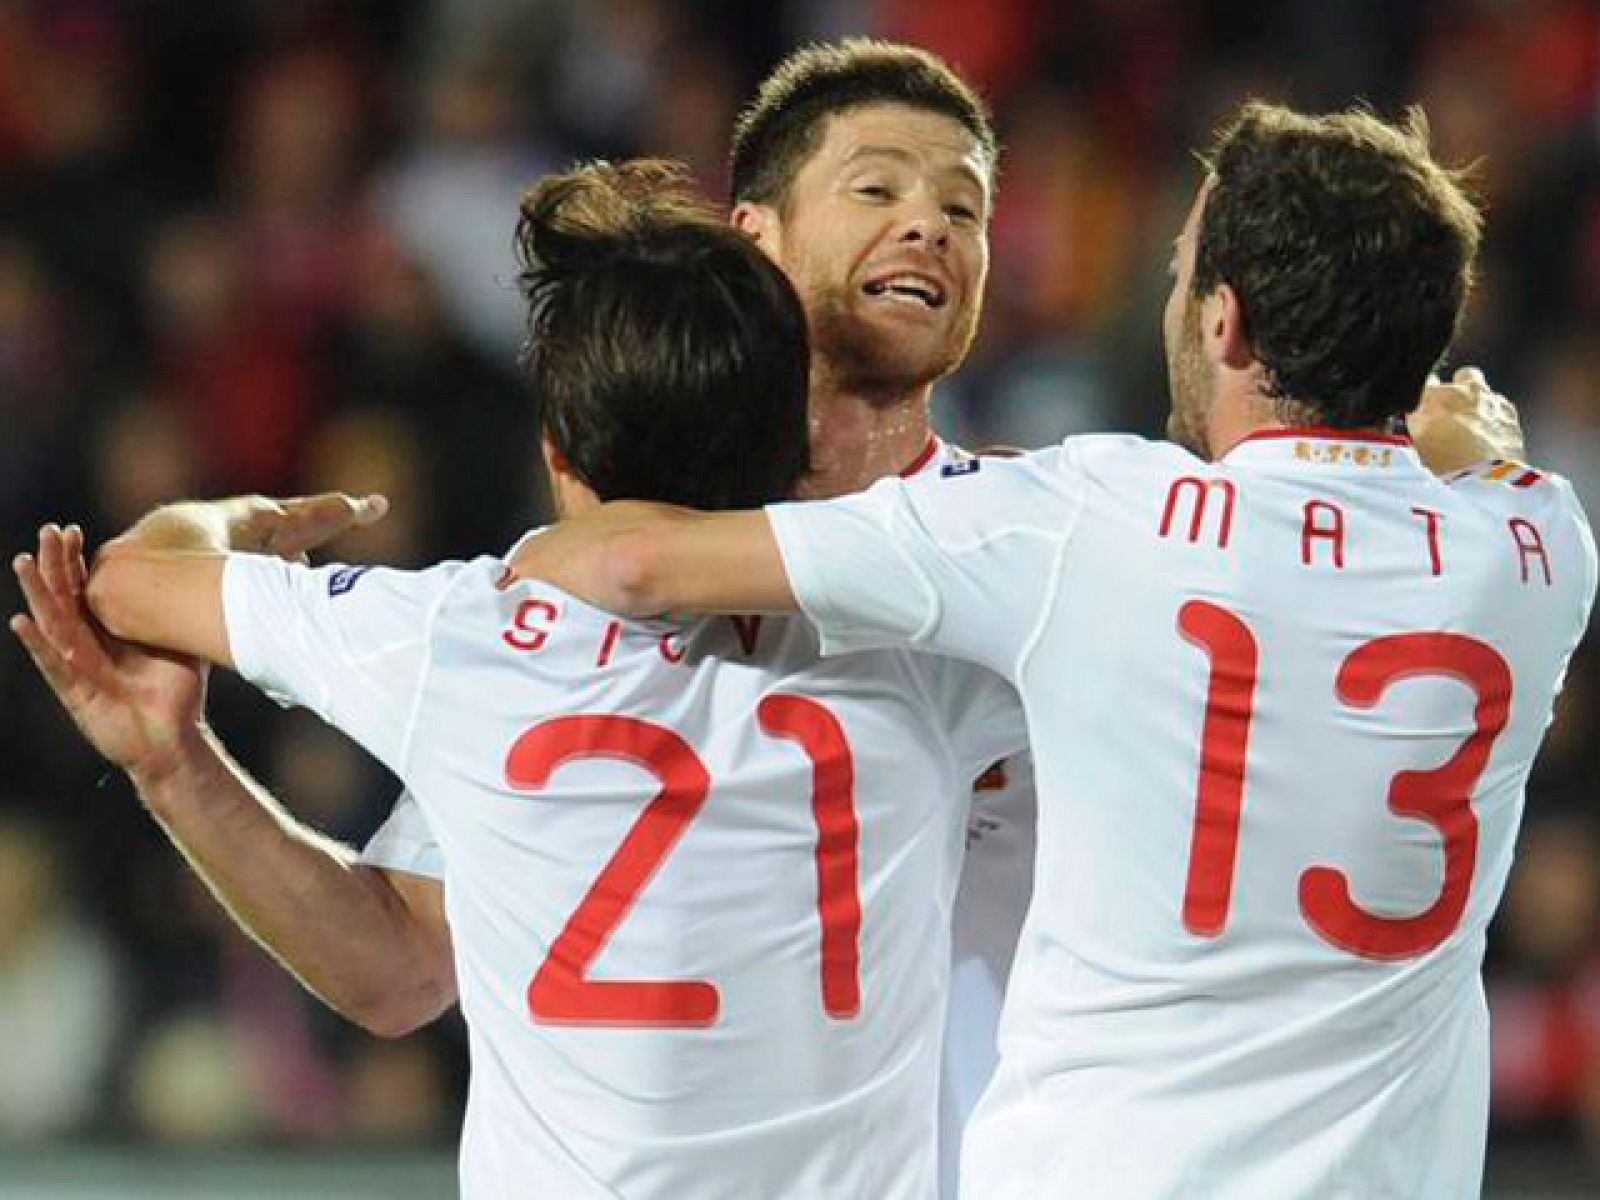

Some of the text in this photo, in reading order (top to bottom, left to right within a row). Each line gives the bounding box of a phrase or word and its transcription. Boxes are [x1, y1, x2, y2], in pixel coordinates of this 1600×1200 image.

[1158, 476, 1553, 587] MATA
[504, 693, 862, 1028] 21
[1177, 599, 1513, 960] 13
